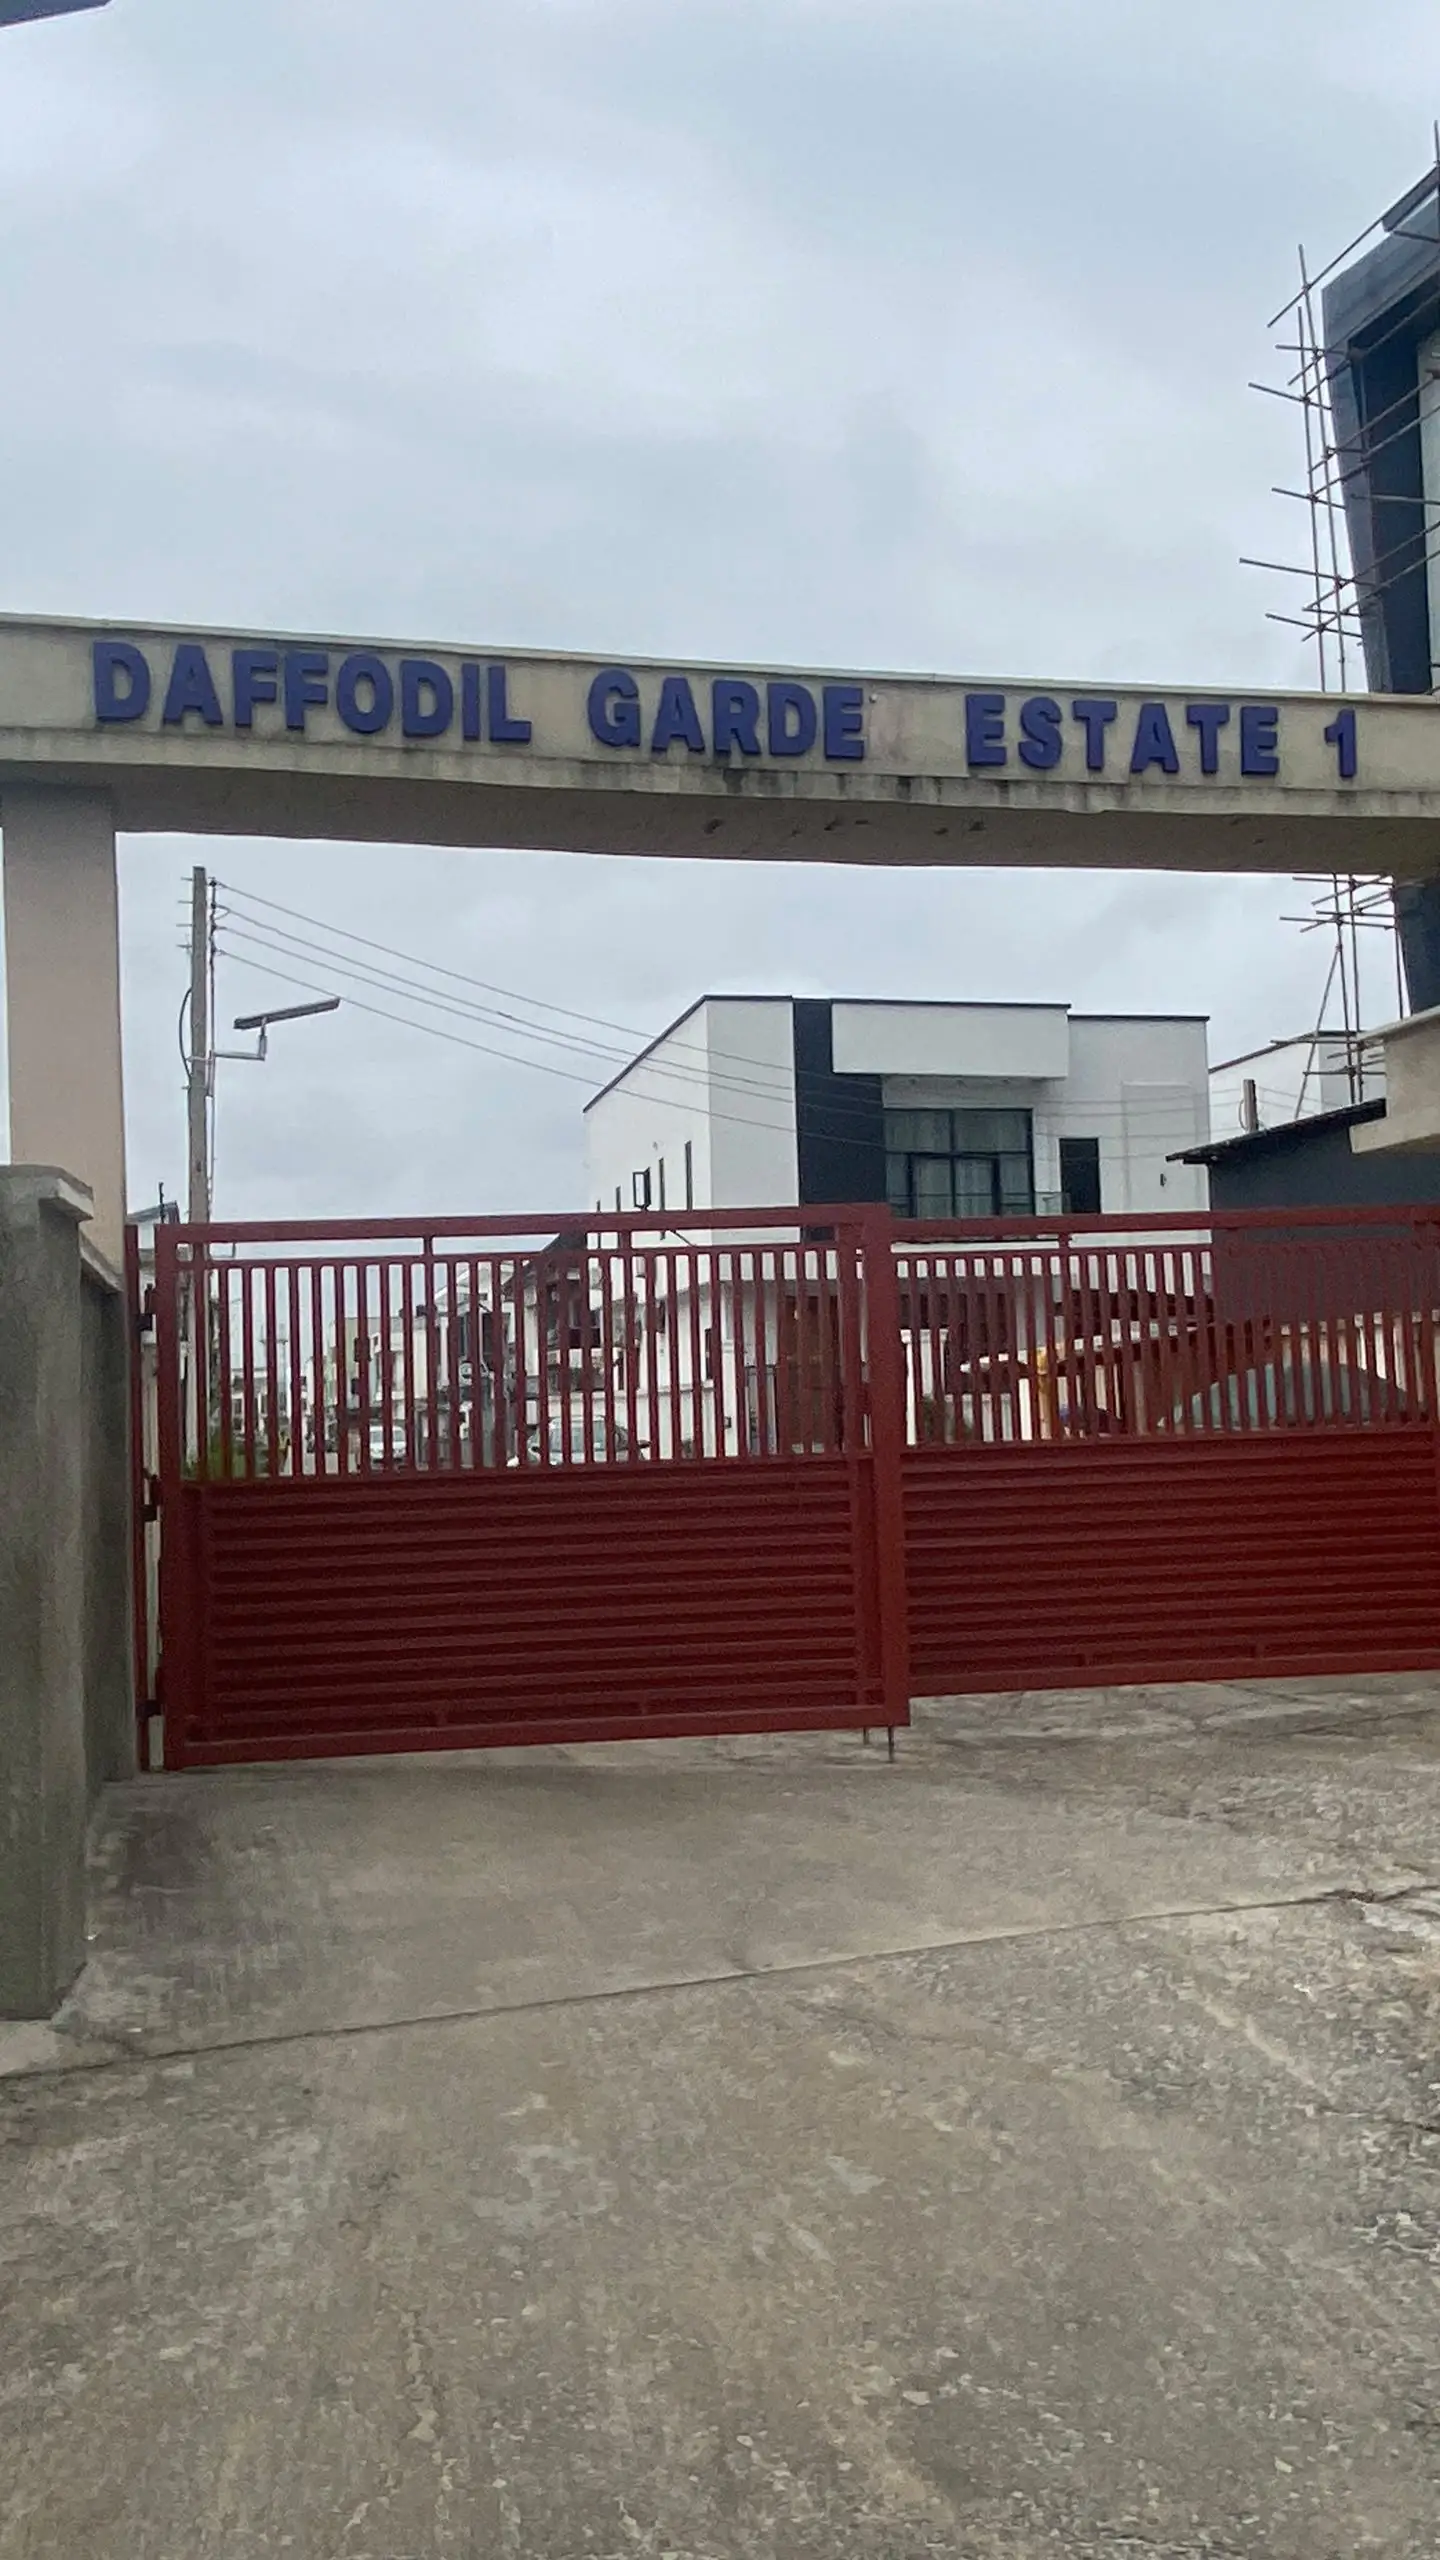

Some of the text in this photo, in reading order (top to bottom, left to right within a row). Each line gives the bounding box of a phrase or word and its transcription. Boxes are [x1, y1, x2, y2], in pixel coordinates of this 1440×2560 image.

[92, 640, 1357, 777] DAFFODIL GARDE ESTATE 1
